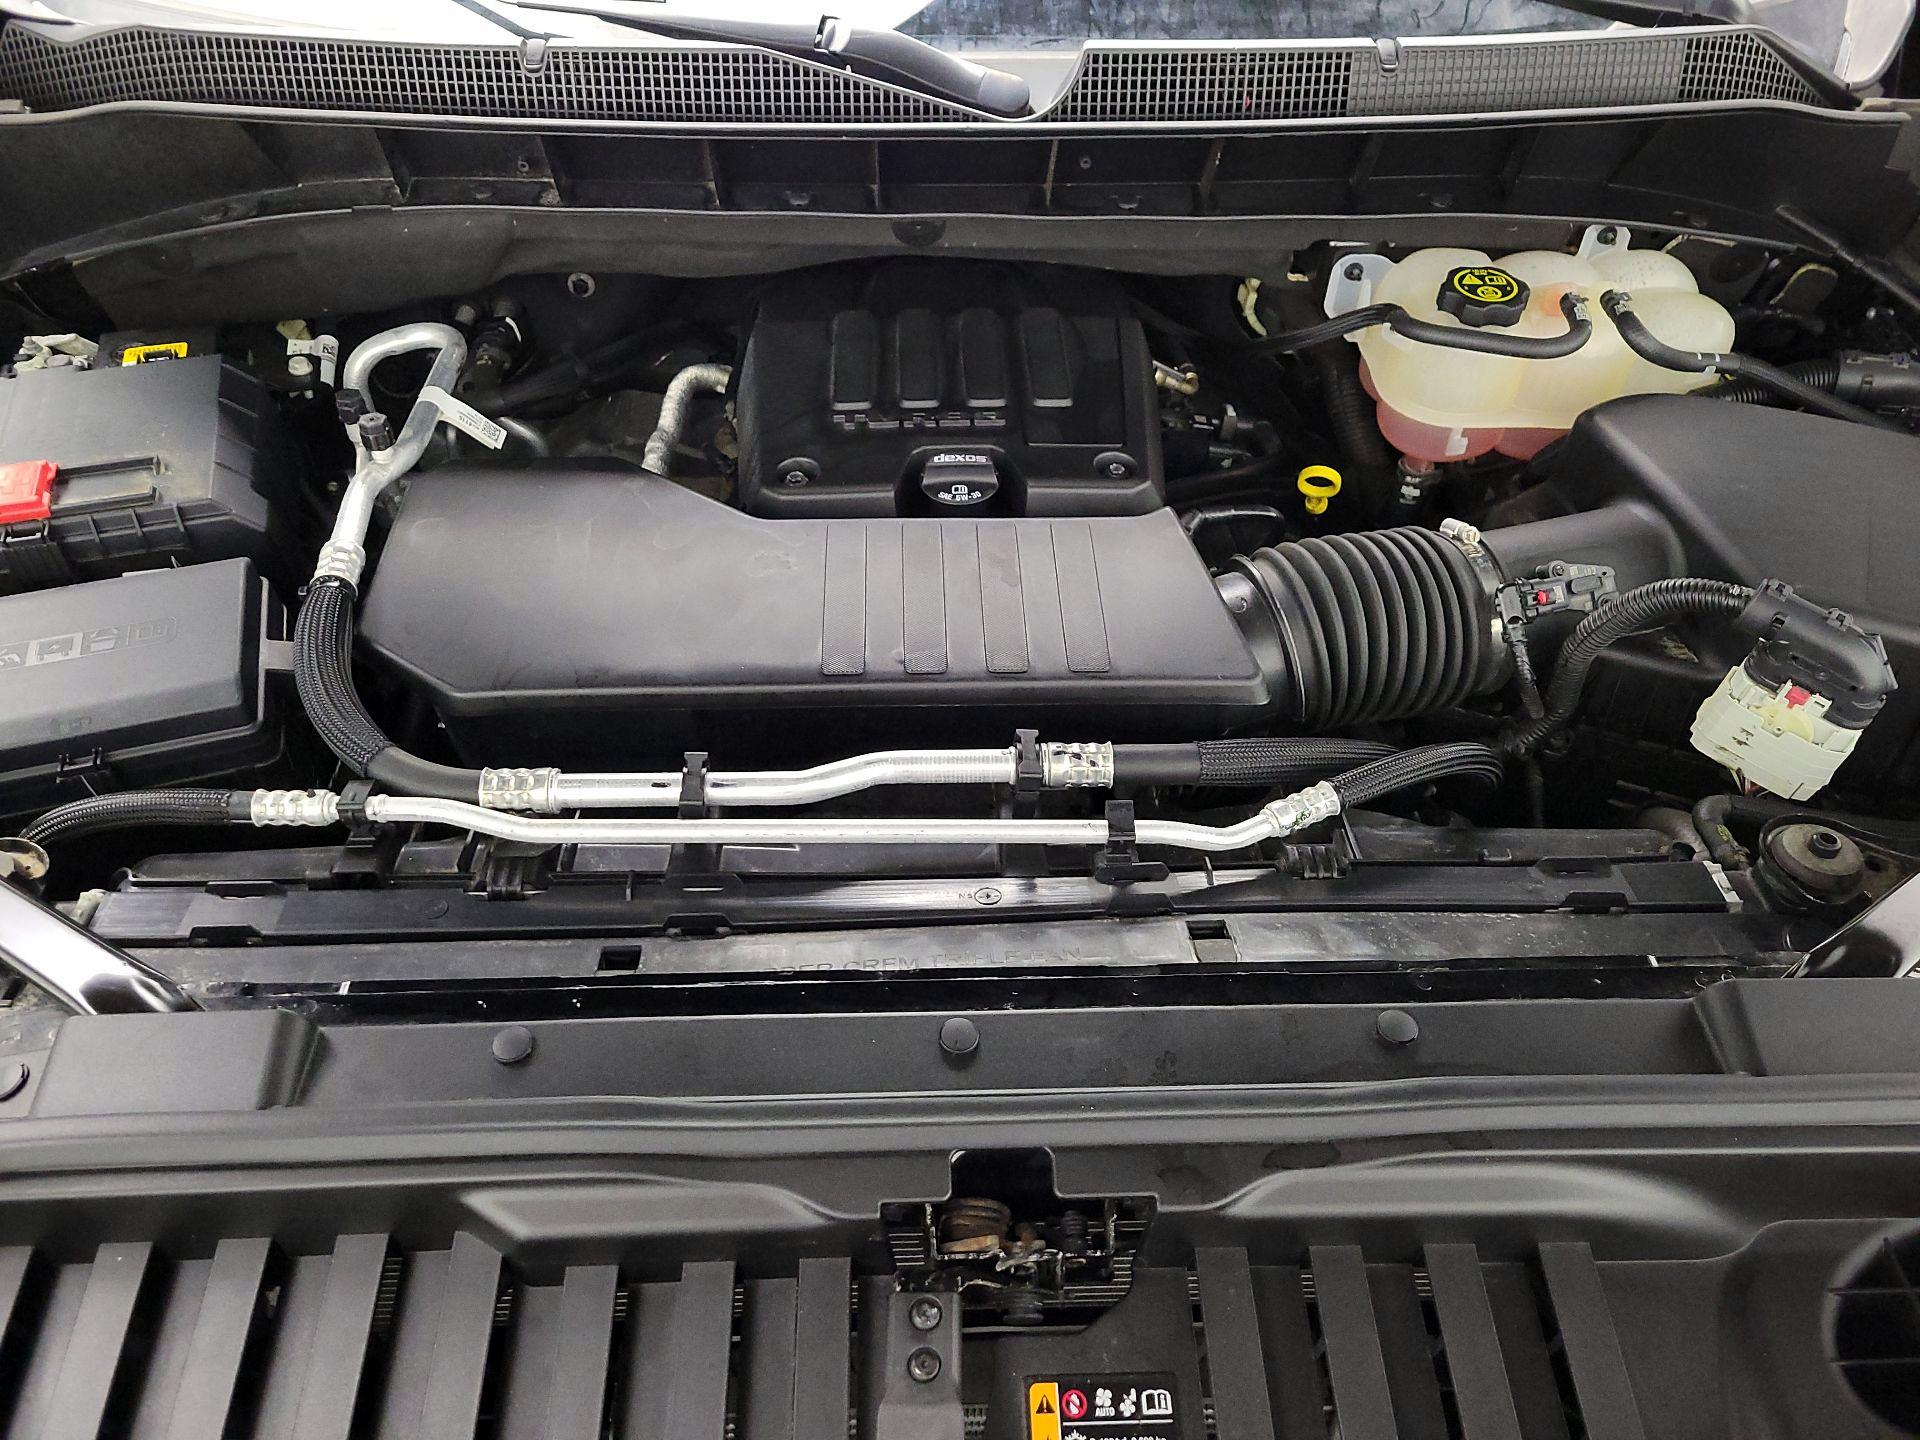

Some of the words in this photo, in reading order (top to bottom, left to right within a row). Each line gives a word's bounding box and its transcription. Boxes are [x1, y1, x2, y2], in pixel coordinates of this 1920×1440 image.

[933, 454, 987, 463] dexos
[938, 491, 953, 500] SAE
[1095, 1407, 1116, 1417] AUTO
